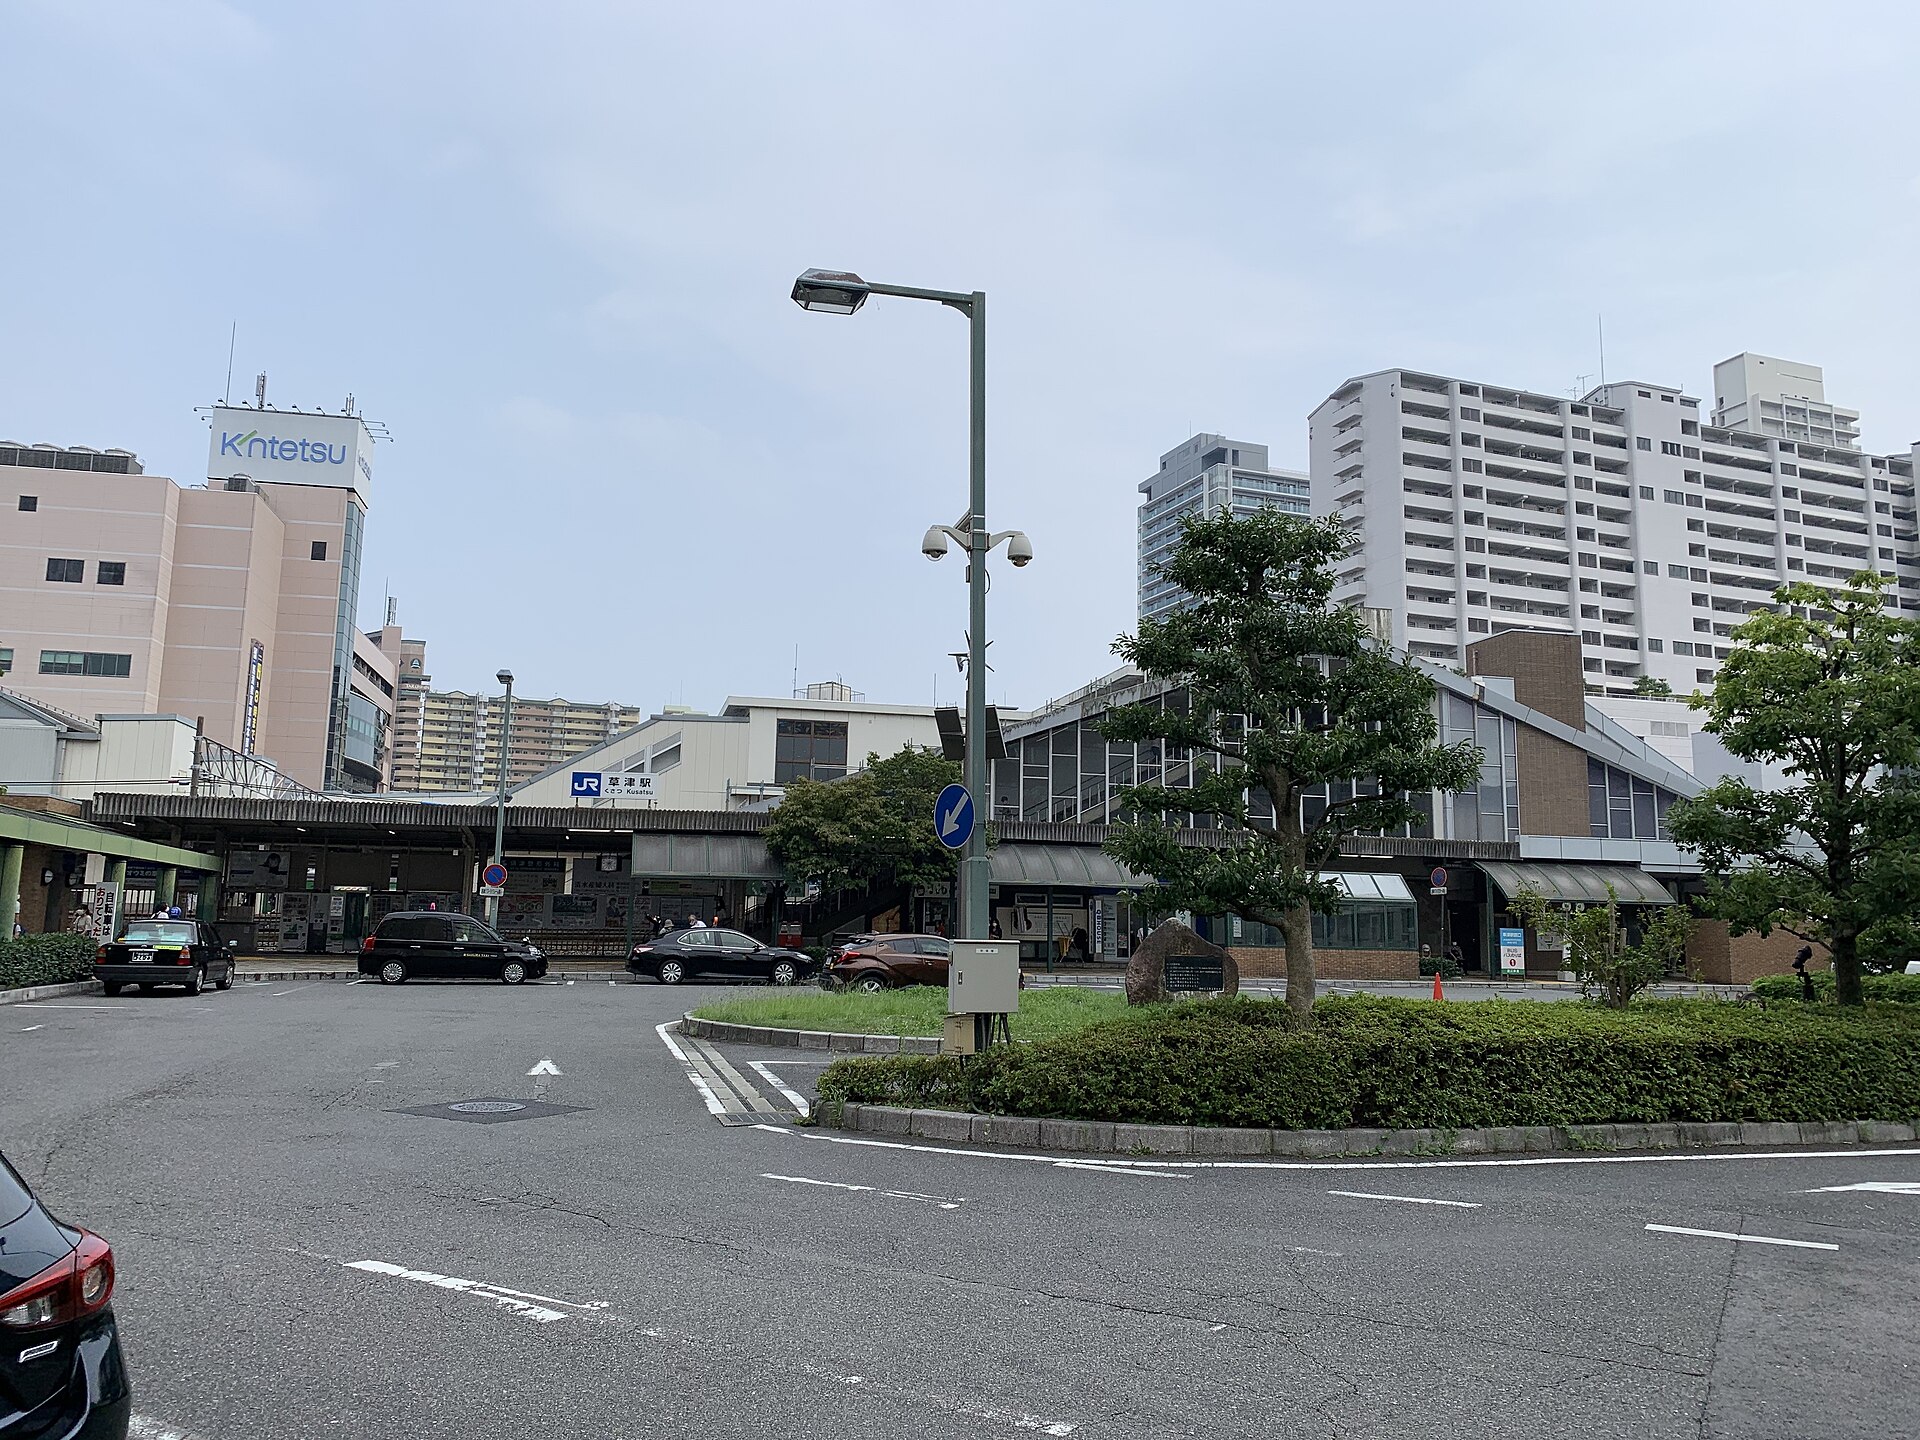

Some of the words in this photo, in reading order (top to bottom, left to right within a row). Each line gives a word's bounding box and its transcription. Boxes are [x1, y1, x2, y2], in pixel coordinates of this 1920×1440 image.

[220, 430, 346, 464] Kintetsu
[574, 777, 599, 791] JR
[608, 777, 651, 788] 草津駅
[102, 891, 115, 936] 自転車は
